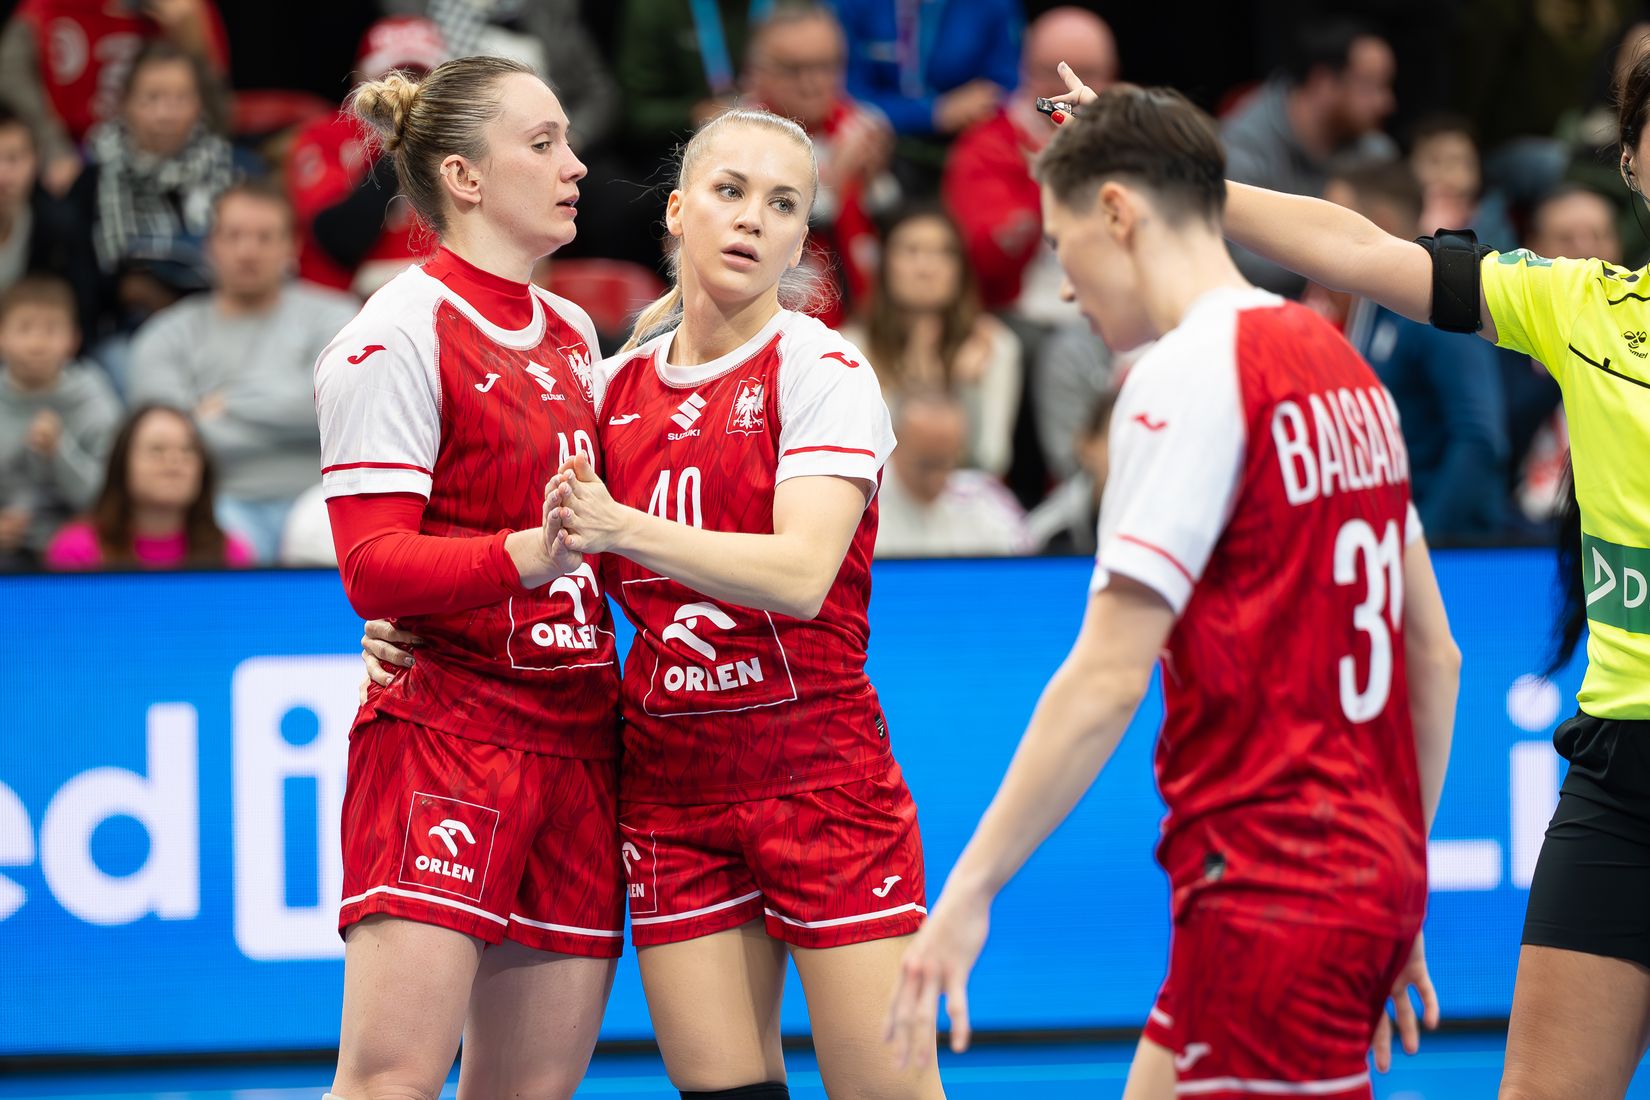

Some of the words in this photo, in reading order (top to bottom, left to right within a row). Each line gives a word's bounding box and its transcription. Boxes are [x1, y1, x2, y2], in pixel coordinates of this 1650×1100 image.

[648, 466, 703, 530] 40
[1623, 566, 1650, 610] D
[1333, 518, 1404, 724] 31
[664, 657, 764, 692] ORLEN
[415, 855, 475, 883] ORLEN
